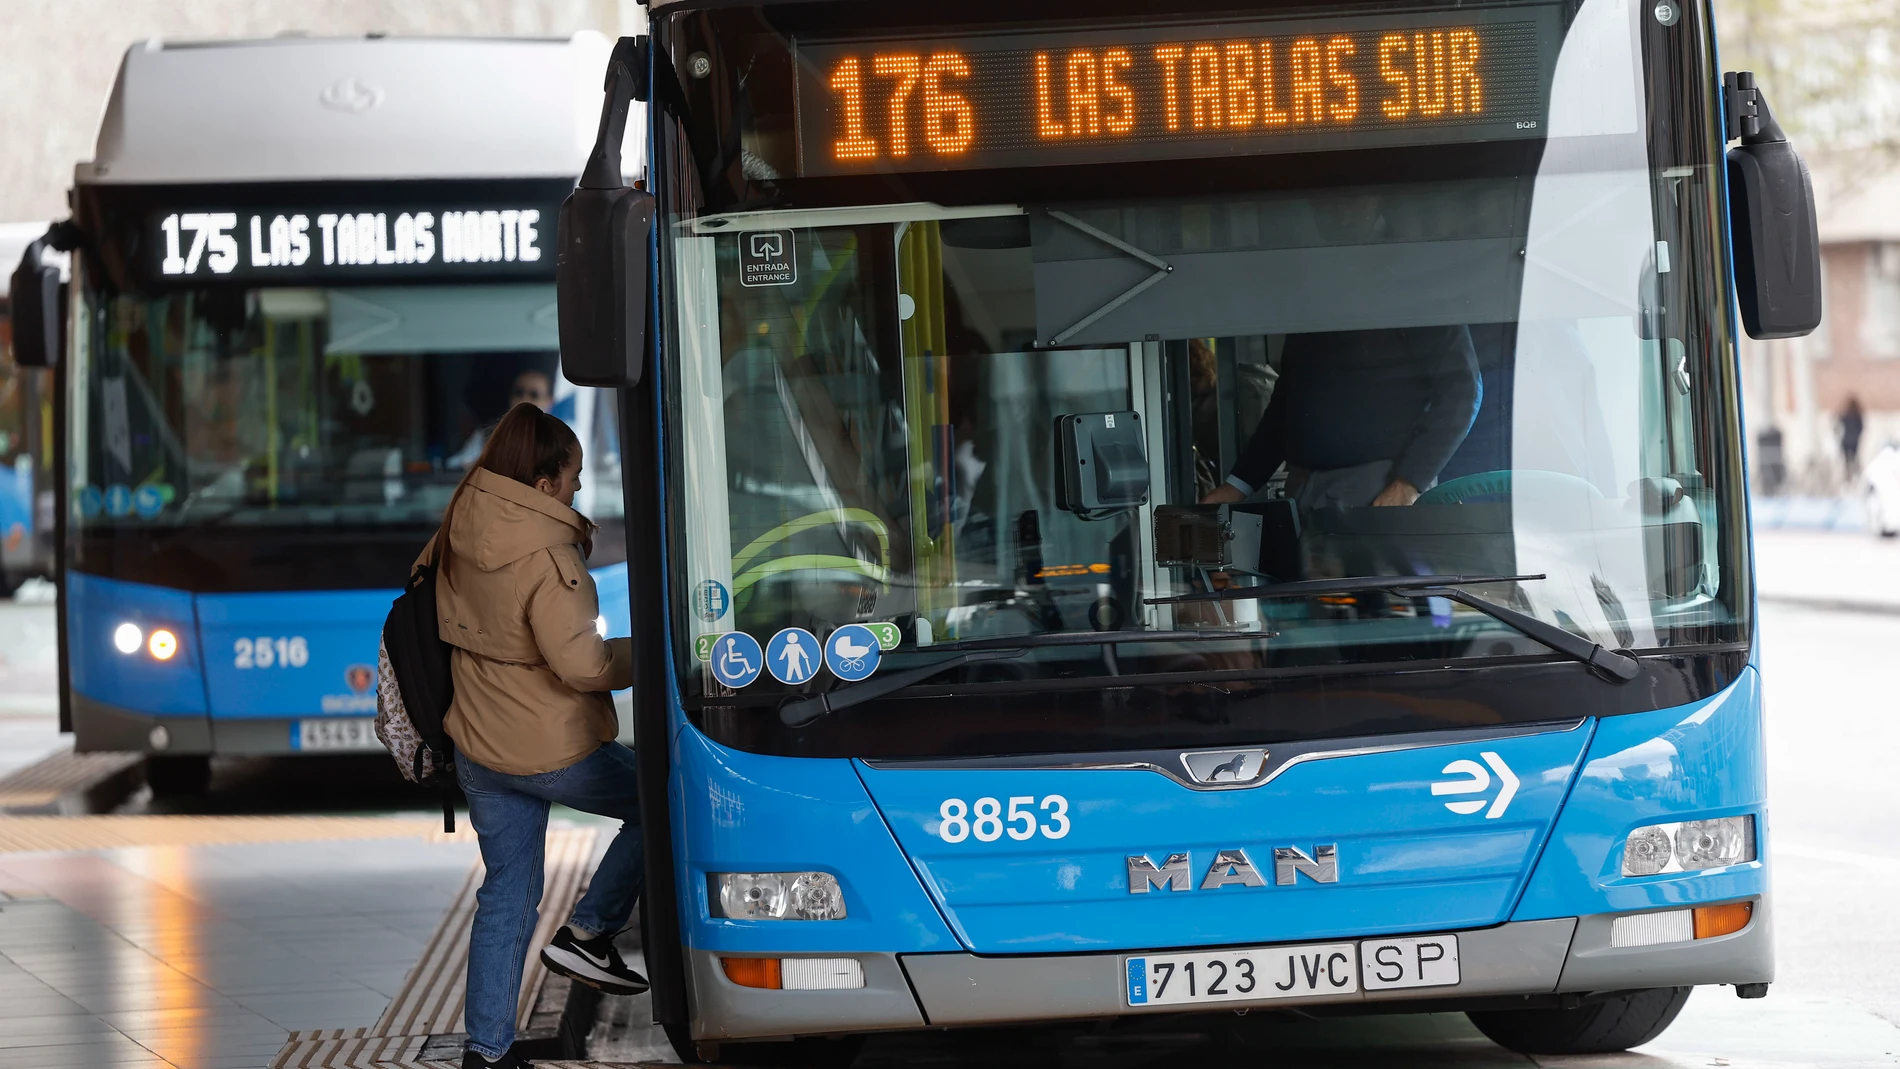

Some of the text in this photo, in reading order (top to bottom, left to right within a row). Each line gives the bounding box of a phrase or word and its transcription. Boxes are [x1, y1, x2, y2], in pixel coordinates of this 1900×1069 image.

[831, 31, 1482, 158] 176 LAS TABLAS SUR
[1516, 121, 1537, 129] BQB
[161, 209, 541, 275] 175 LAS TABLAS NORTE
[747, 262, 790, 272] ENTRADA
[747, 273, 790, 282] ENTRANCE
[699, 638, 709, 654] 2
[882, 626, 894, 643] 3
[234, 636, 309, 669] 2516
[939, 794, 1071, 844] 8853
[1126, 842, 1339, 894] MAN
[1134, 952, 1349, 999] E 7123 JVC
